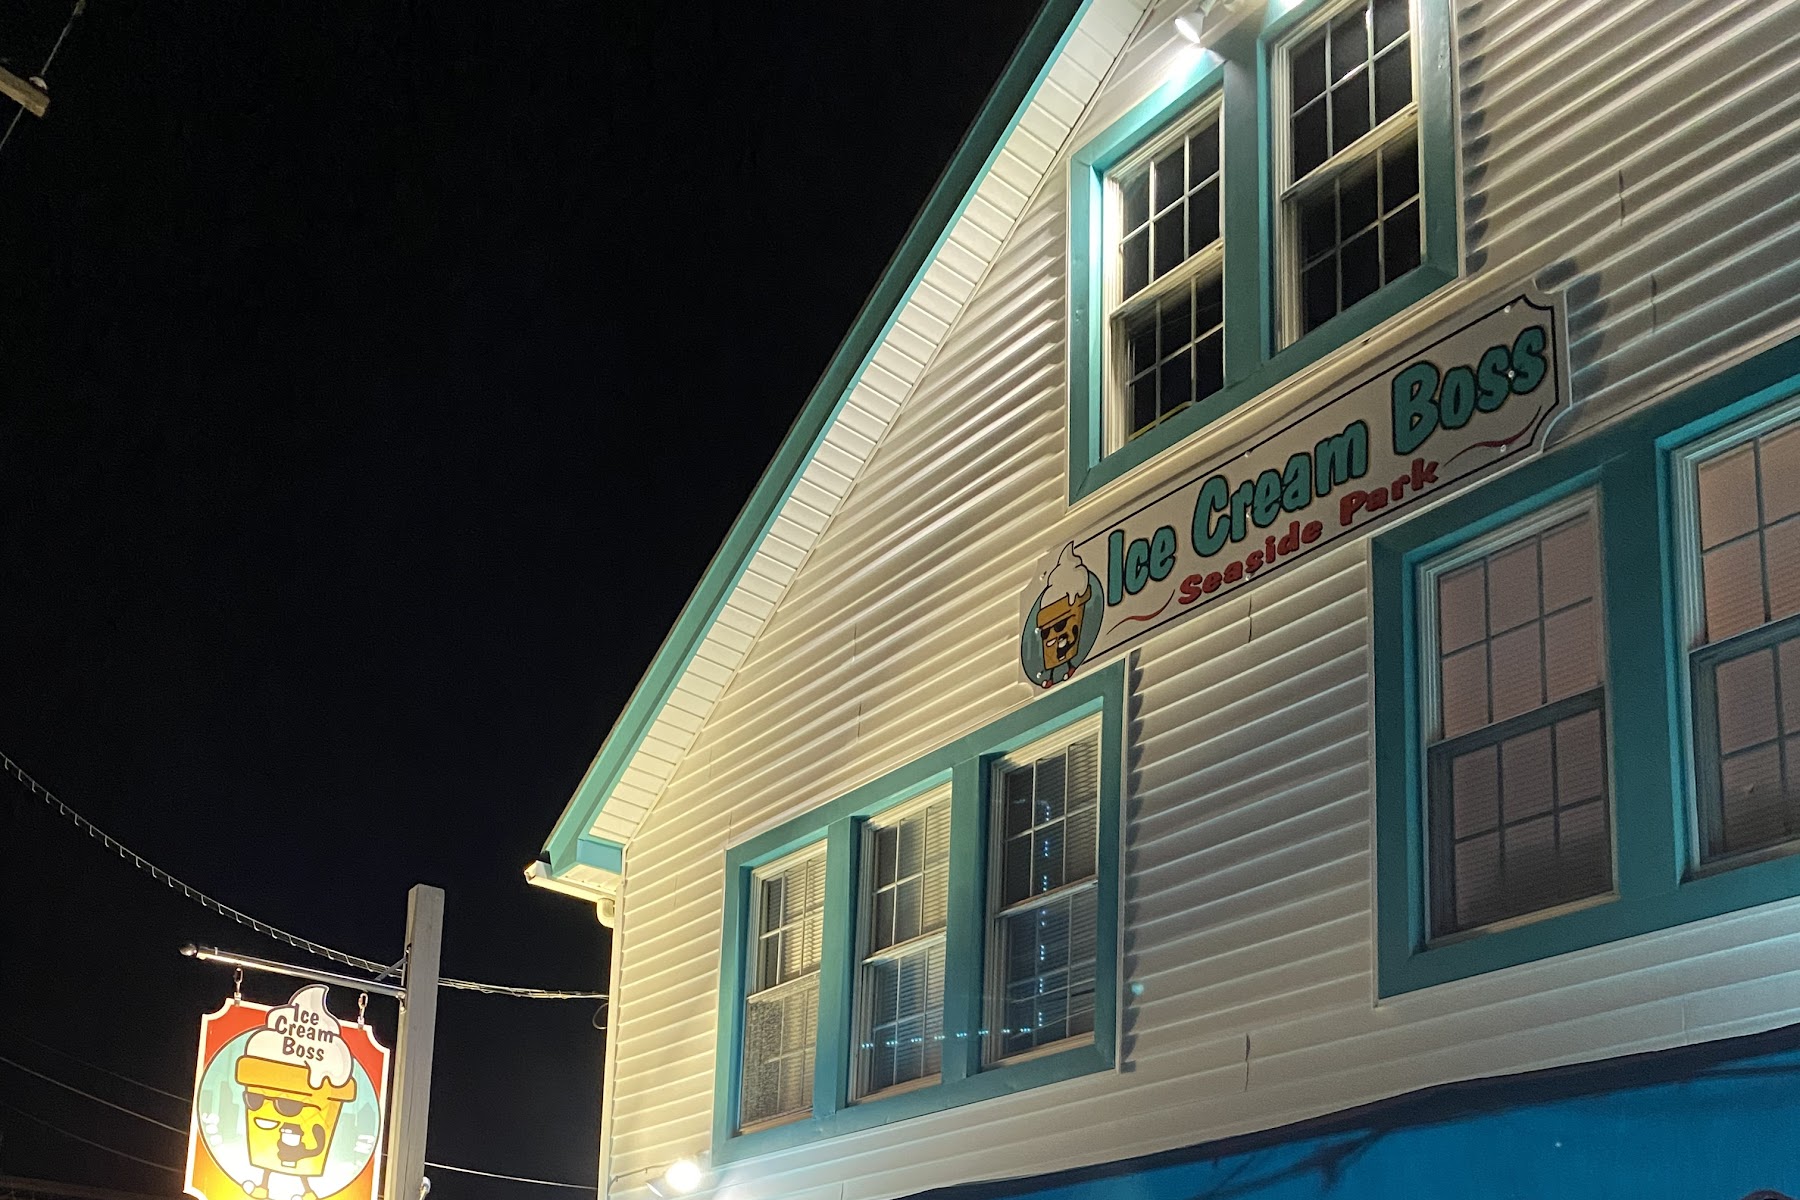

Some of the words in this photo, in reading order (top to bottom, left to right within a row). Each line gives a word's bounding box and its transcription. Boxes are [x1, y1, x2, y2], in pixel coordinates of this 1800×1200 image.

[1107, 524, 1177, 607] Ice
[1192, 418, 1369, 557] Cream
[1391, 324, 1548, 456] Boss
[1177, 516, 1324, 605] Seaside
[1339, 457, 1440, 526] Park
[293, 1002, 320, 1026] Ice
[274, 1015, 337, 1044] Cream
[282, 1036, 325, 1062] Boss
